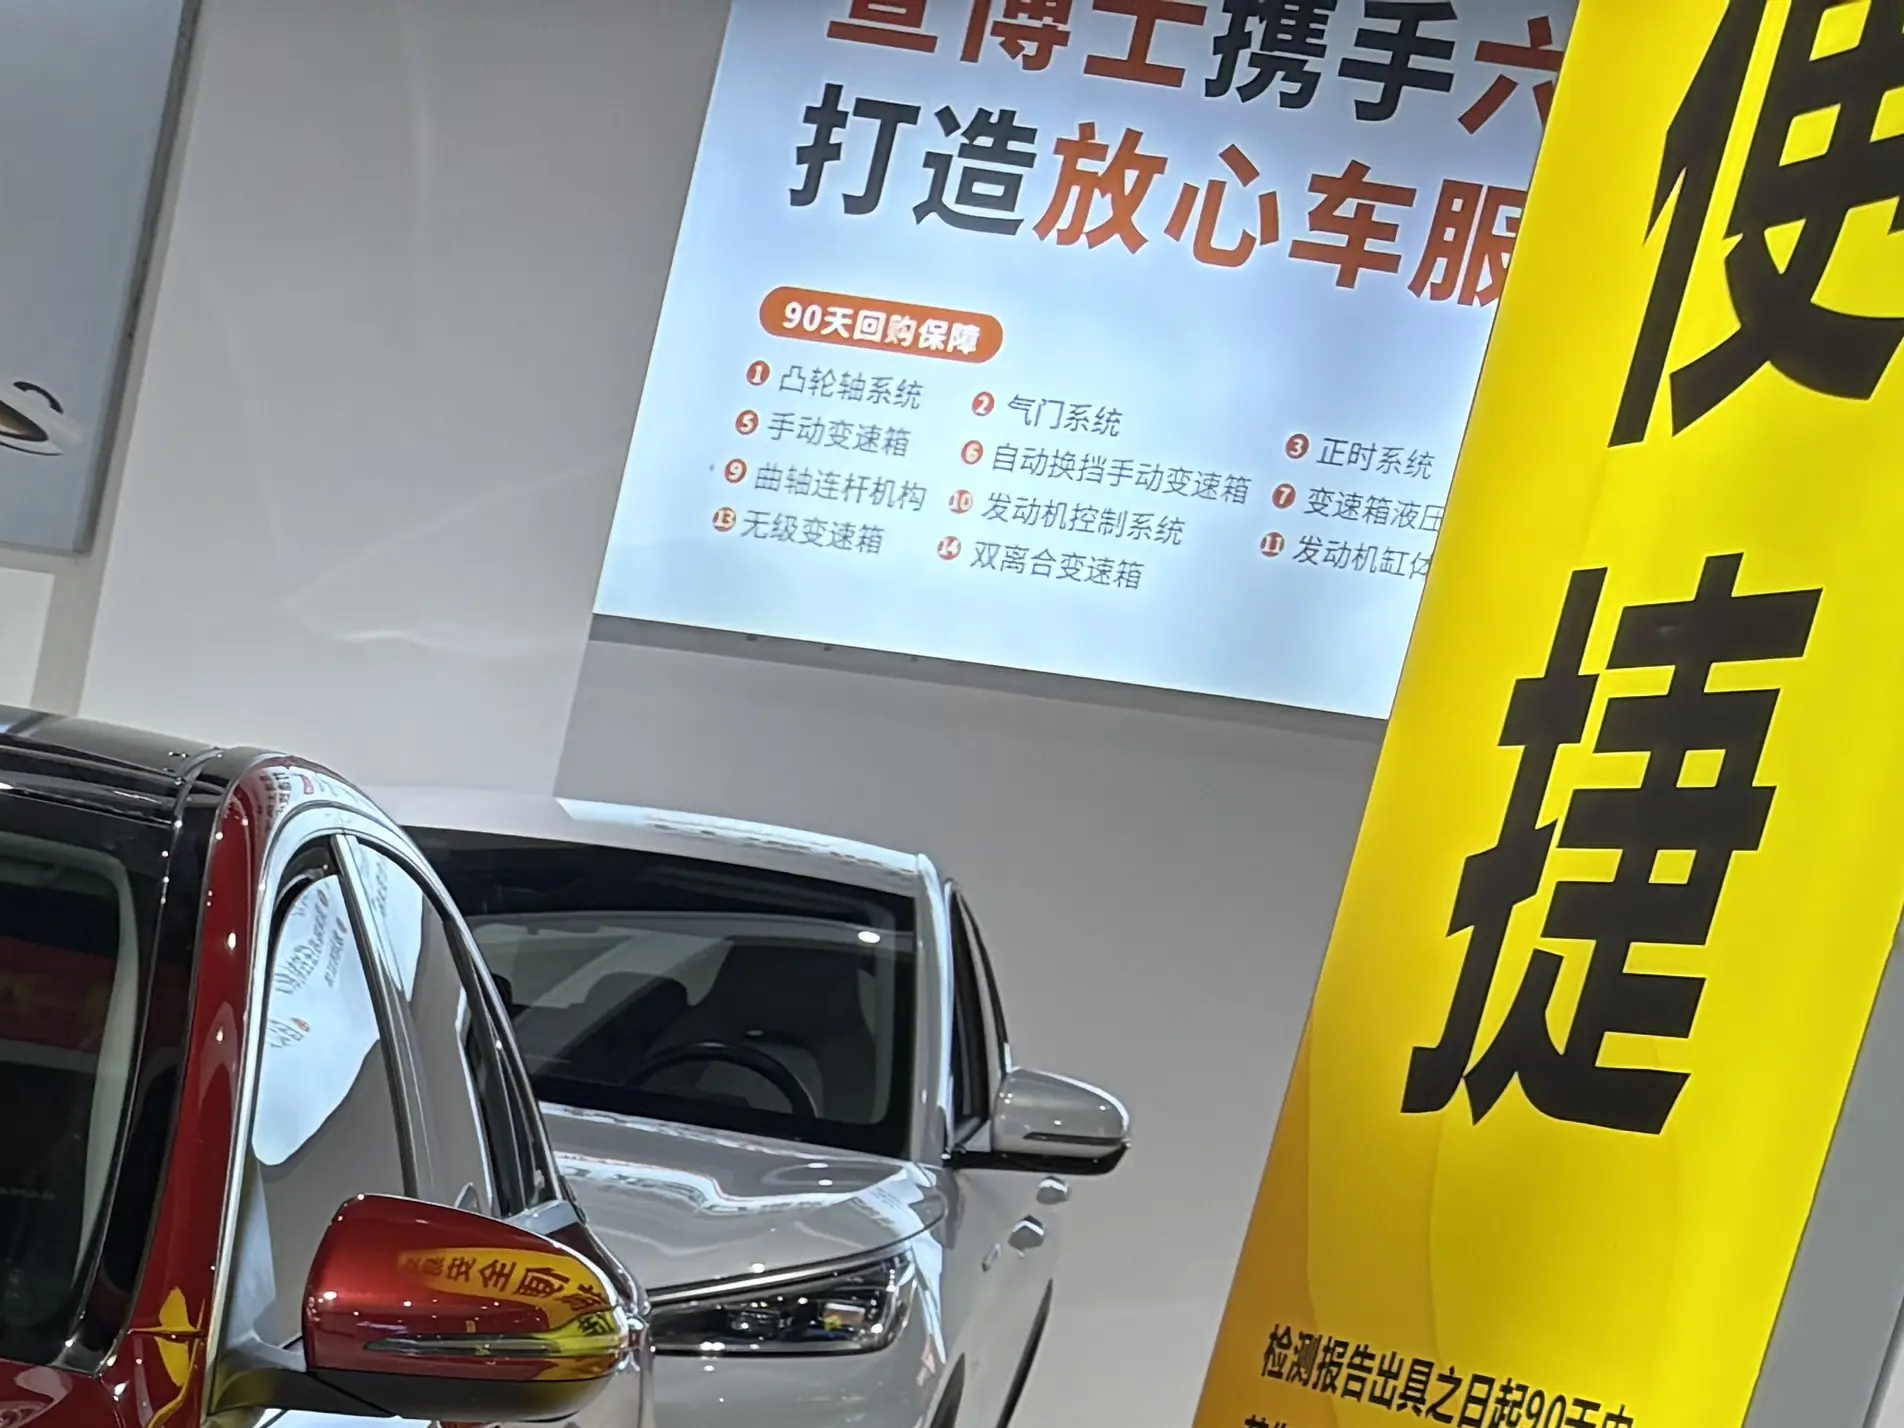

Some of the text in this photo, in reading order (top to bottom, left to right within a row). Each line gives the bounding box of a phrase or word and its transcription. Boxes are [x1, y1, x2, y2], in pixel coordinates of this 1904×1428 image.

[782, 300, 982, 356] 90天回购保障
[778, 365, 925, 411] 凸轮轴系统
[767, 411, 912, 458] 手动变速箱
[1006, 394, 1124, 438] 气门系统
[992, 443, 1253, 506] 自动换挡手动变速箱
[1316, 436, 1436, 480] 正时系统
[754, 464, 928, 513] 曲轴连杆机构
[740, 508, 886, 556] 无级变速箱
[981, 492, 1186, 547] 发动机控制系统
[970, 539, 1146, 591] 双离合变速箱
